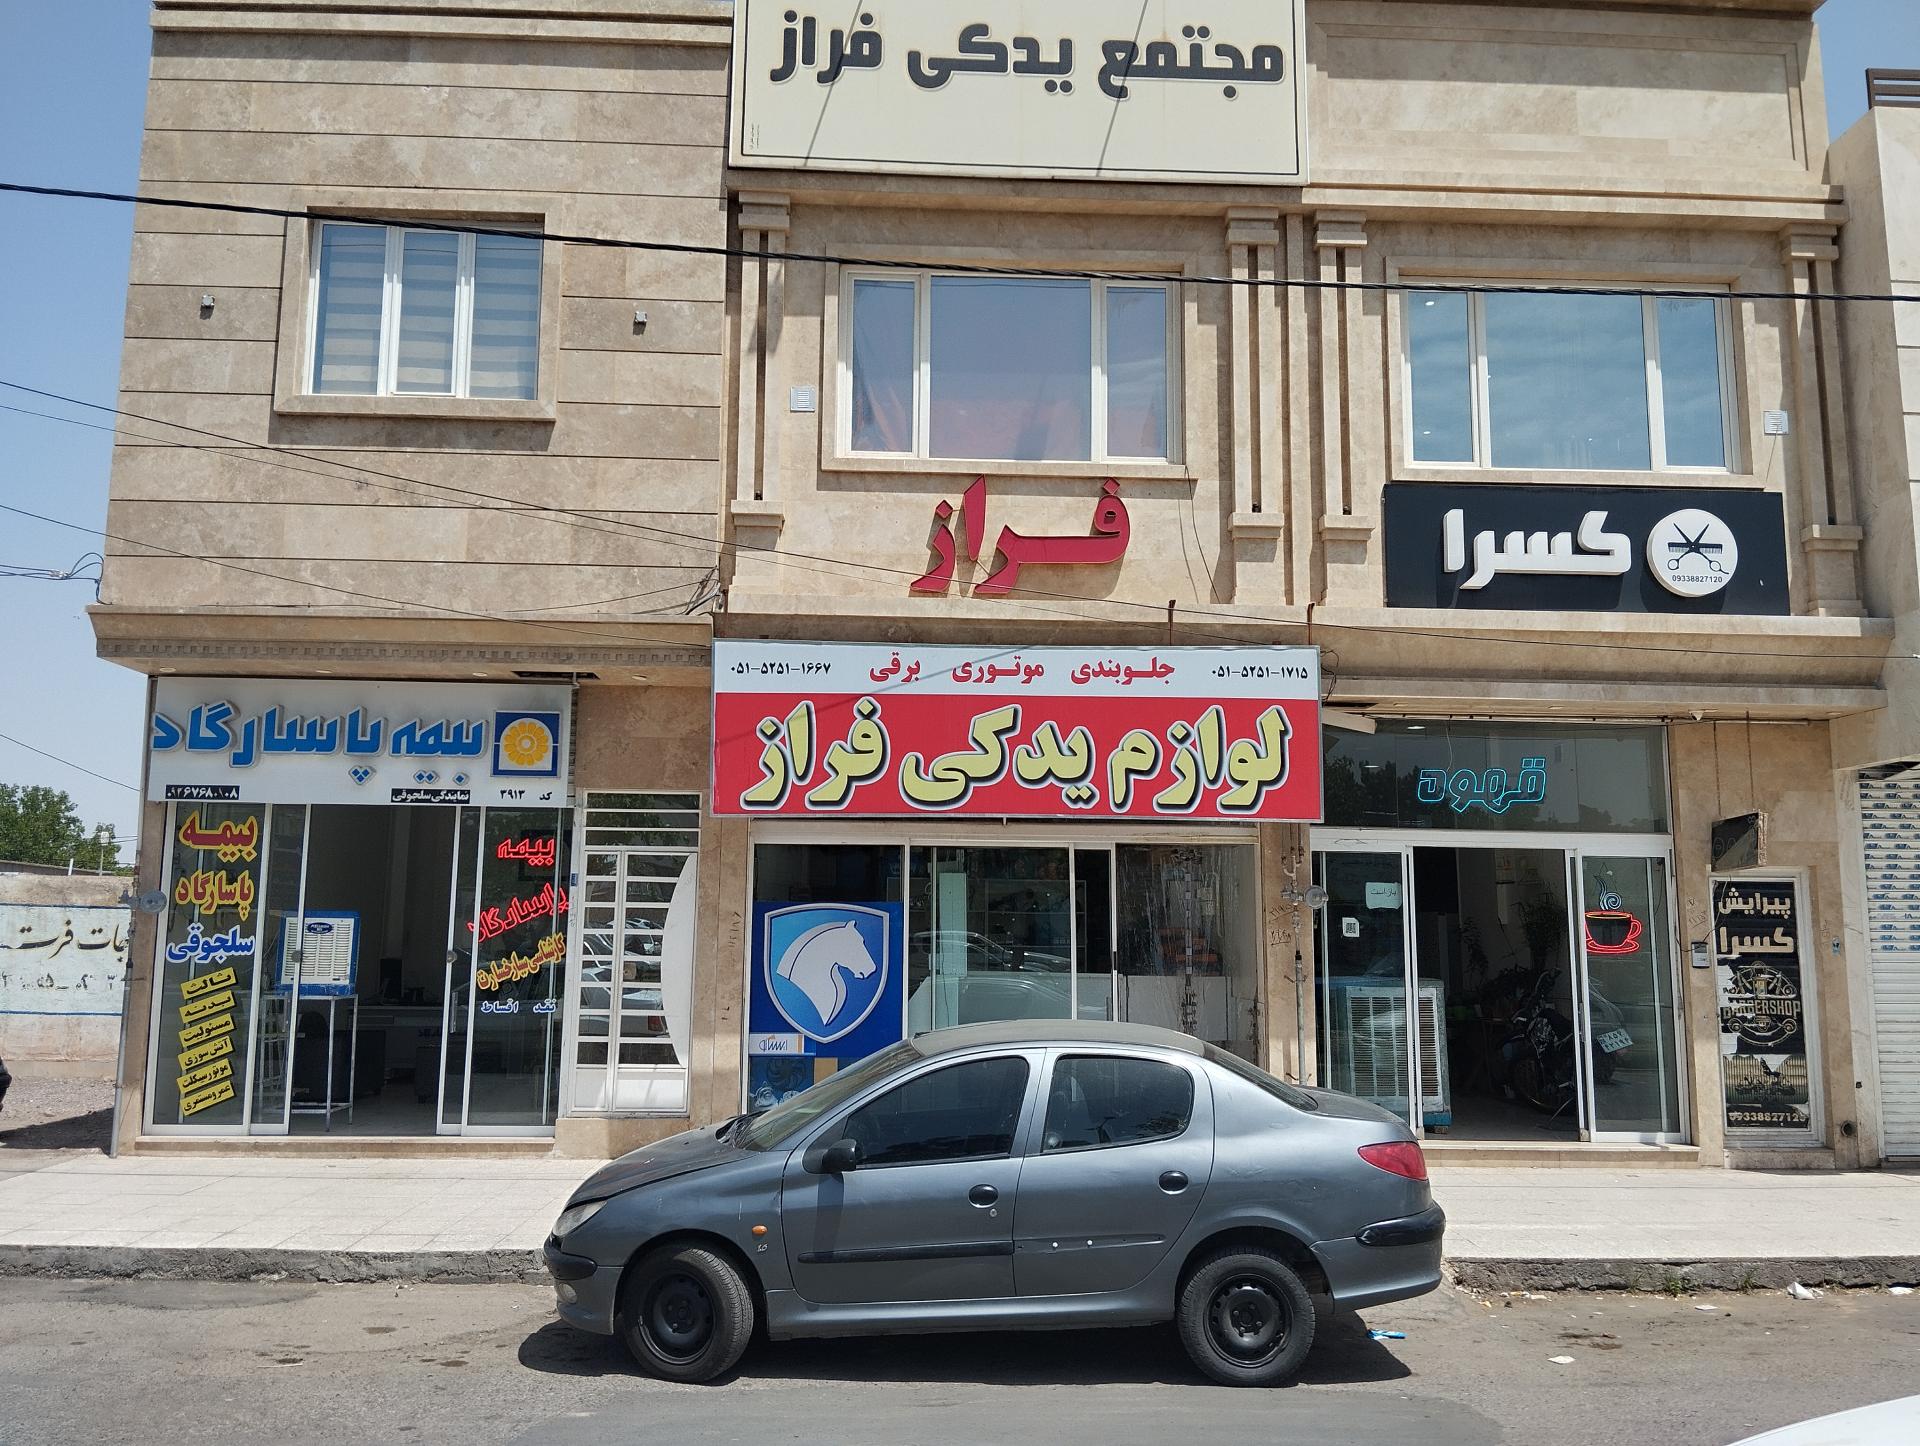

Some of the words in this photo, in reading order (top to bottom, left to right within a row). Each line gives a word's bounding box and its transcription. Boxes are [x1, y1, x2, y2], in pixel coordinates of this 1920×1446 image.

[770, 9, 884, 85] فراز
[907, 23, 1074, 94] یدکی
[1099, 24, 1285, 99] مجتمع
[910, 473, 1131, 594] فراز
[1443, 508, 1632, 590] کسرا
[1671, 574, 1723, 583] 09338827120
[869, 652, 921, 683] برقی
[951, 655, 1045, 684] موتوری
[1071, 656, 1175, 685] جلوبندی
[152, 699, 388, 785] پاسارگاد
[389, 717, 490, 786] بیمه
[740, 696, 892, 810] فراز
[900, 703, 1100, 809] یدکی
[1108, 704, 1293, 812] لوازم
[392, 790, 431, 803] سلجوقی
[431, 789, 469, 802] نمایندگی
[500, 789, 525, 800] ۳۹۱۳
[539, 791, 552, 801] کد
[179, 810, 259, 862] بیمه
[496, 838, 555, 867] بیمه
[175, 869, 255, 922] پاسارگاد
[1718, 887, 1791, 919] پیرایش
[166, 922, 256, 963] سلجوقی
[529, 932, 566, 973] کارشناسی
[1719, 926, 1795, 956] کسرا
[186, 972, 232, 995] ثالث
[476, 958, 513, 991] خسارت
[184, 996, 231, 1017] بدنه
[480, 998, 519, 1013] اقساط
[533, 998, 557, 1013] نقد
[183, 1020, 231, 1042] مسئولیت
